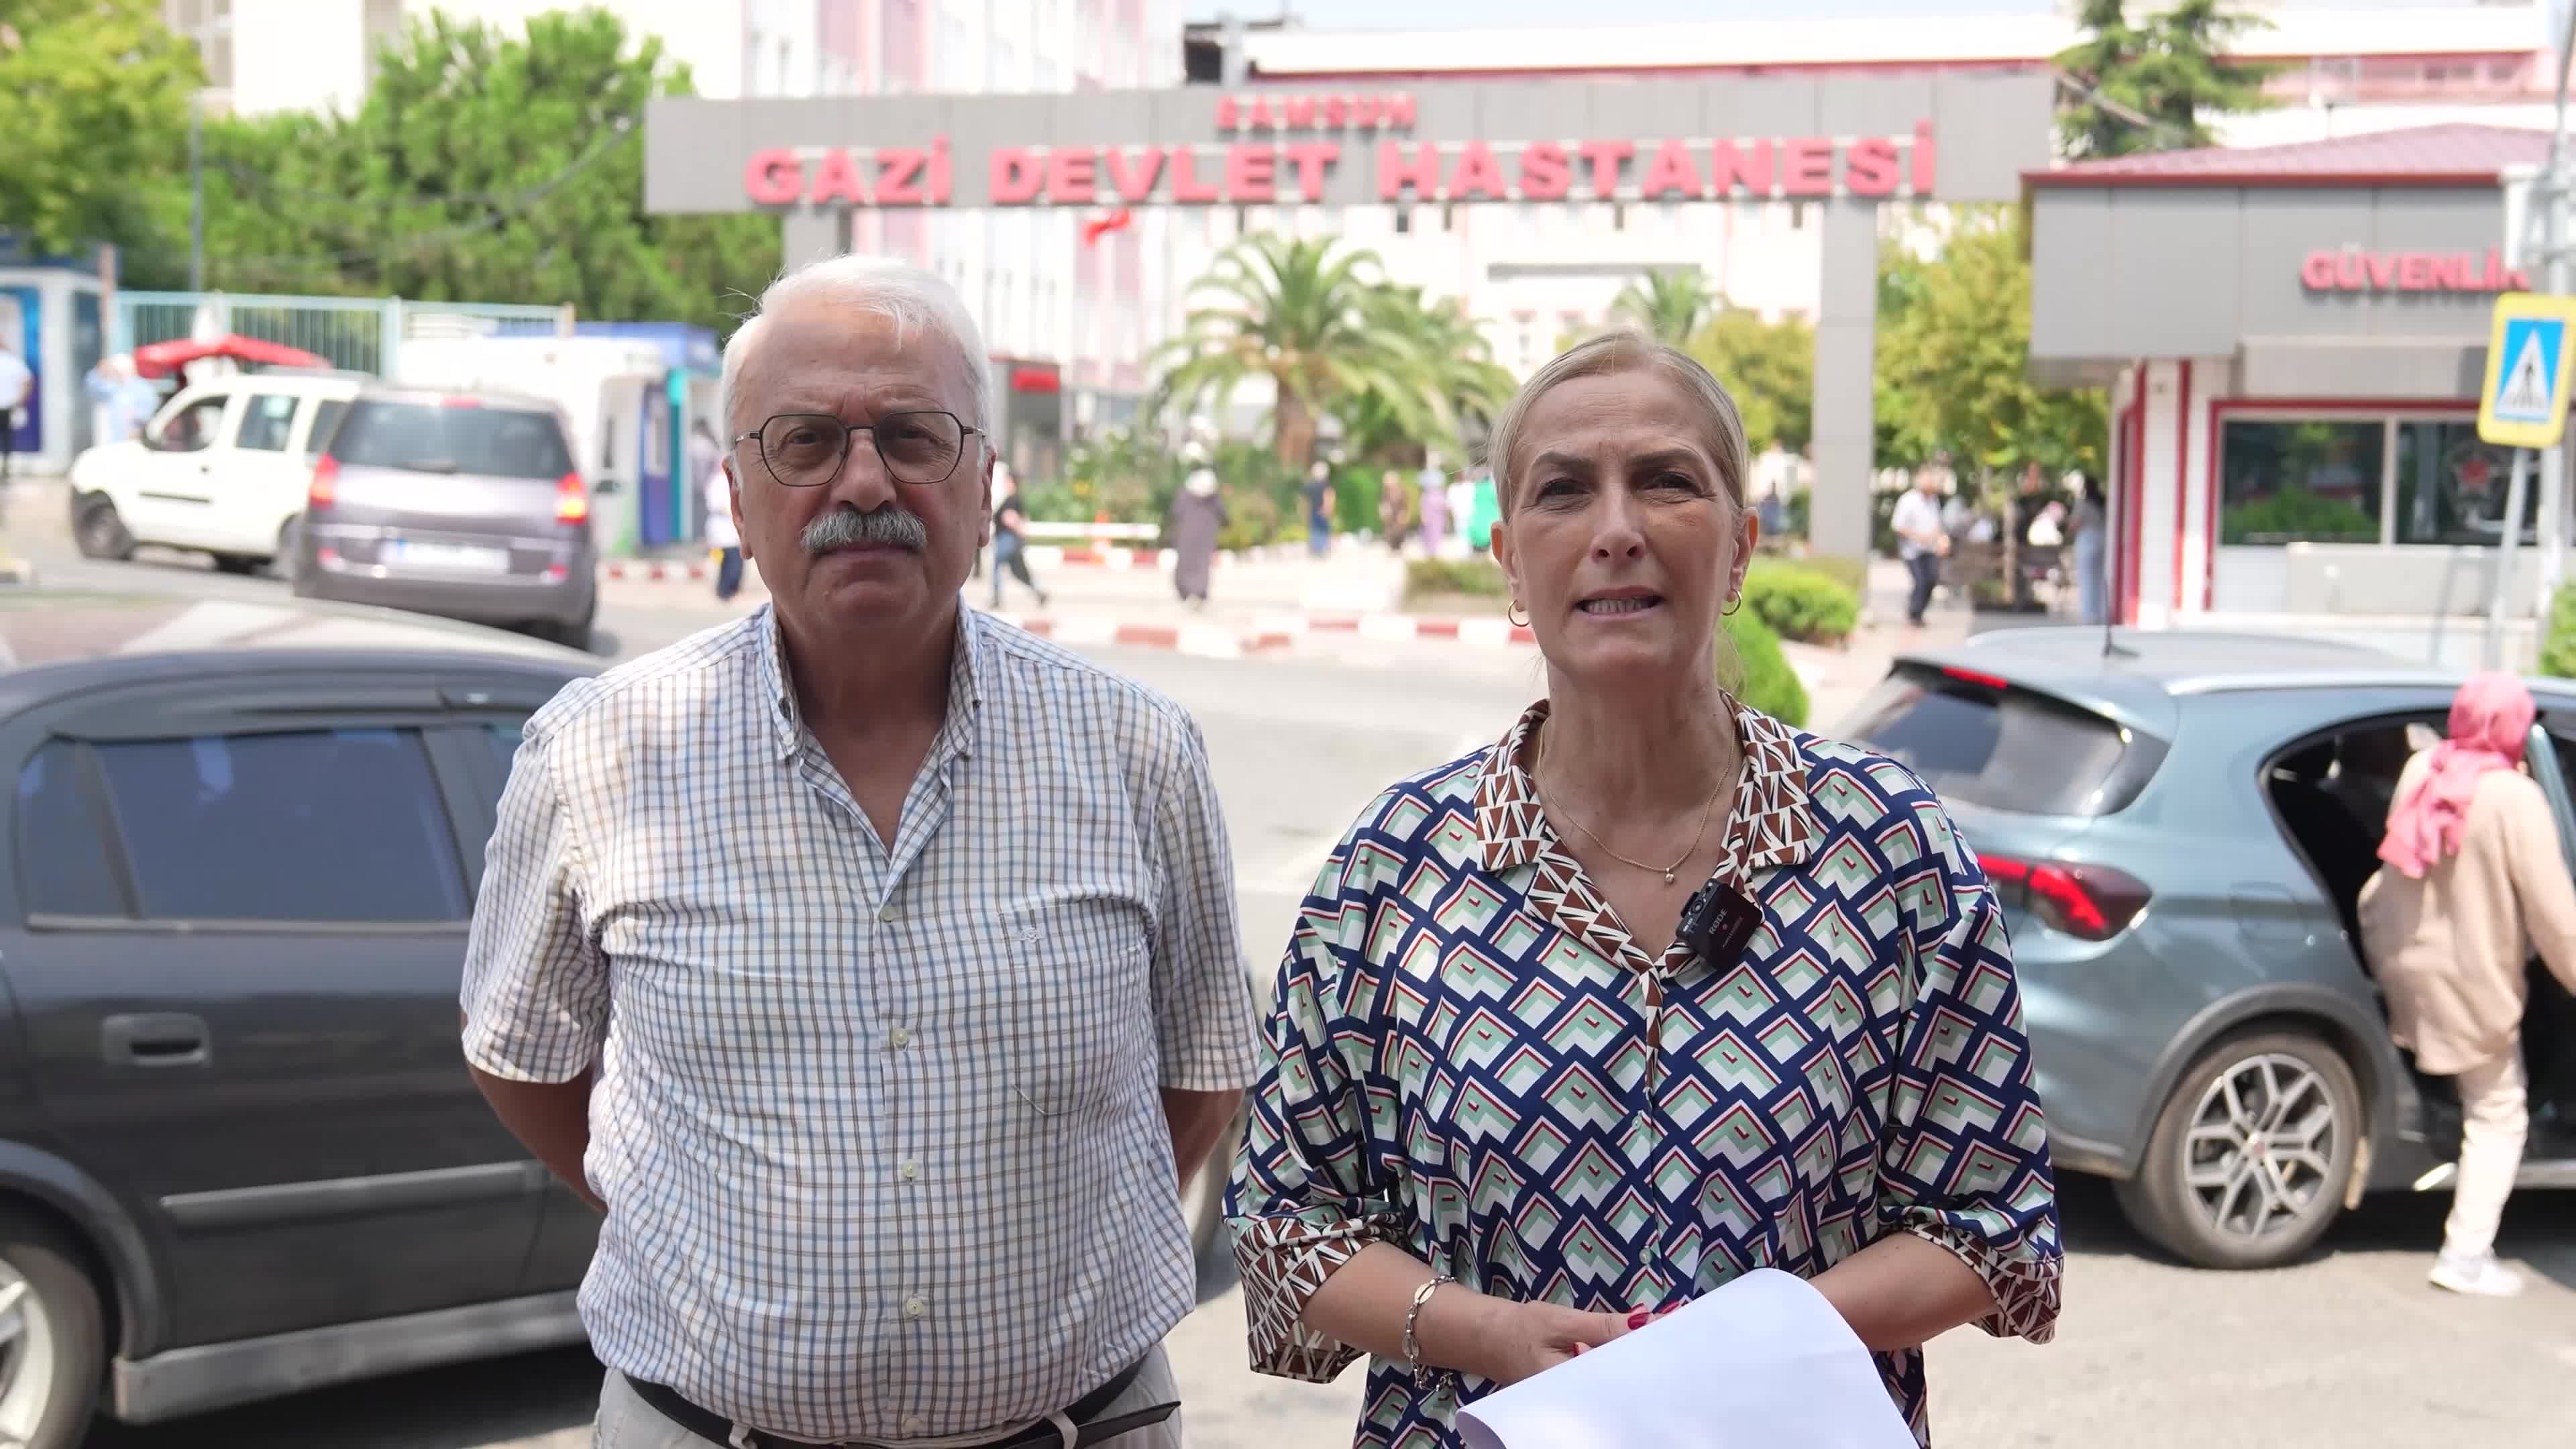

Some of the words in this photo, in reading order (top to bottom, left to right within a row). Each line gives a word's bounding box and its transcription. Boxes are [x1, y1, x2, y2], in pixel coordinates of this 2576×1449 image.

[1216, 95, 1415, 129] SAMSUN
[745, 133, 953, 205] GAZİ
[989, 144, 1340, 204] DEVLET
[1379, 118, 1936, 203] HASTANESİ
